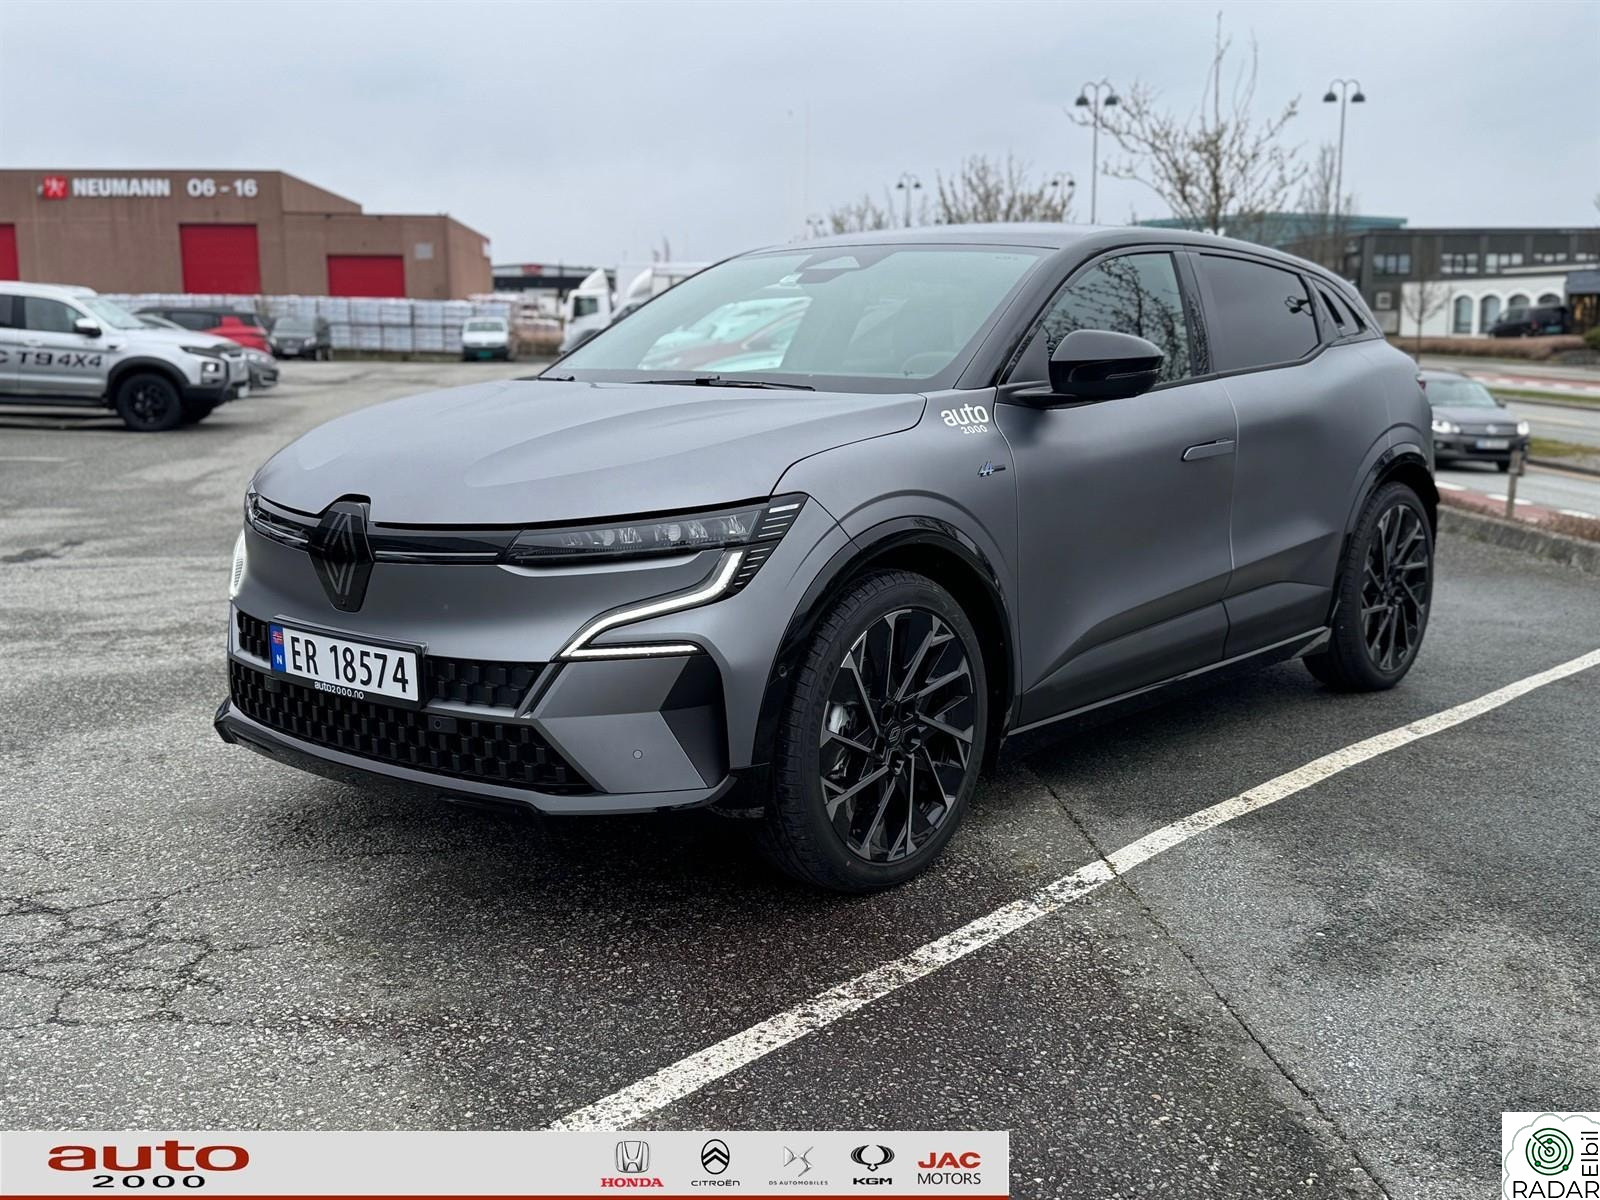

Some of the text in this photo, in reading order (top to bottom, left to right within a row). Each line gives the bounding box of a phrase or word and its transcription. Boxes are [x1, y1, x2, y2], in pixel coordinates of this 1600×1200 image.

[72, 178, 171, 197] NEUMANN
[187, 178, 216, 197] 06
[234, 178, 258, 197] 16
[16, 351, 53, 366] T9
[58, 354, 102, 368] 4X4
[940, 403, 989, 427] auto
[960, 424, 988, 434] 2000
[276, 654, 283, 665] N
[290, 635, 409, 693] ER 18574
[314, 681, 365, 700] auto2000.no
